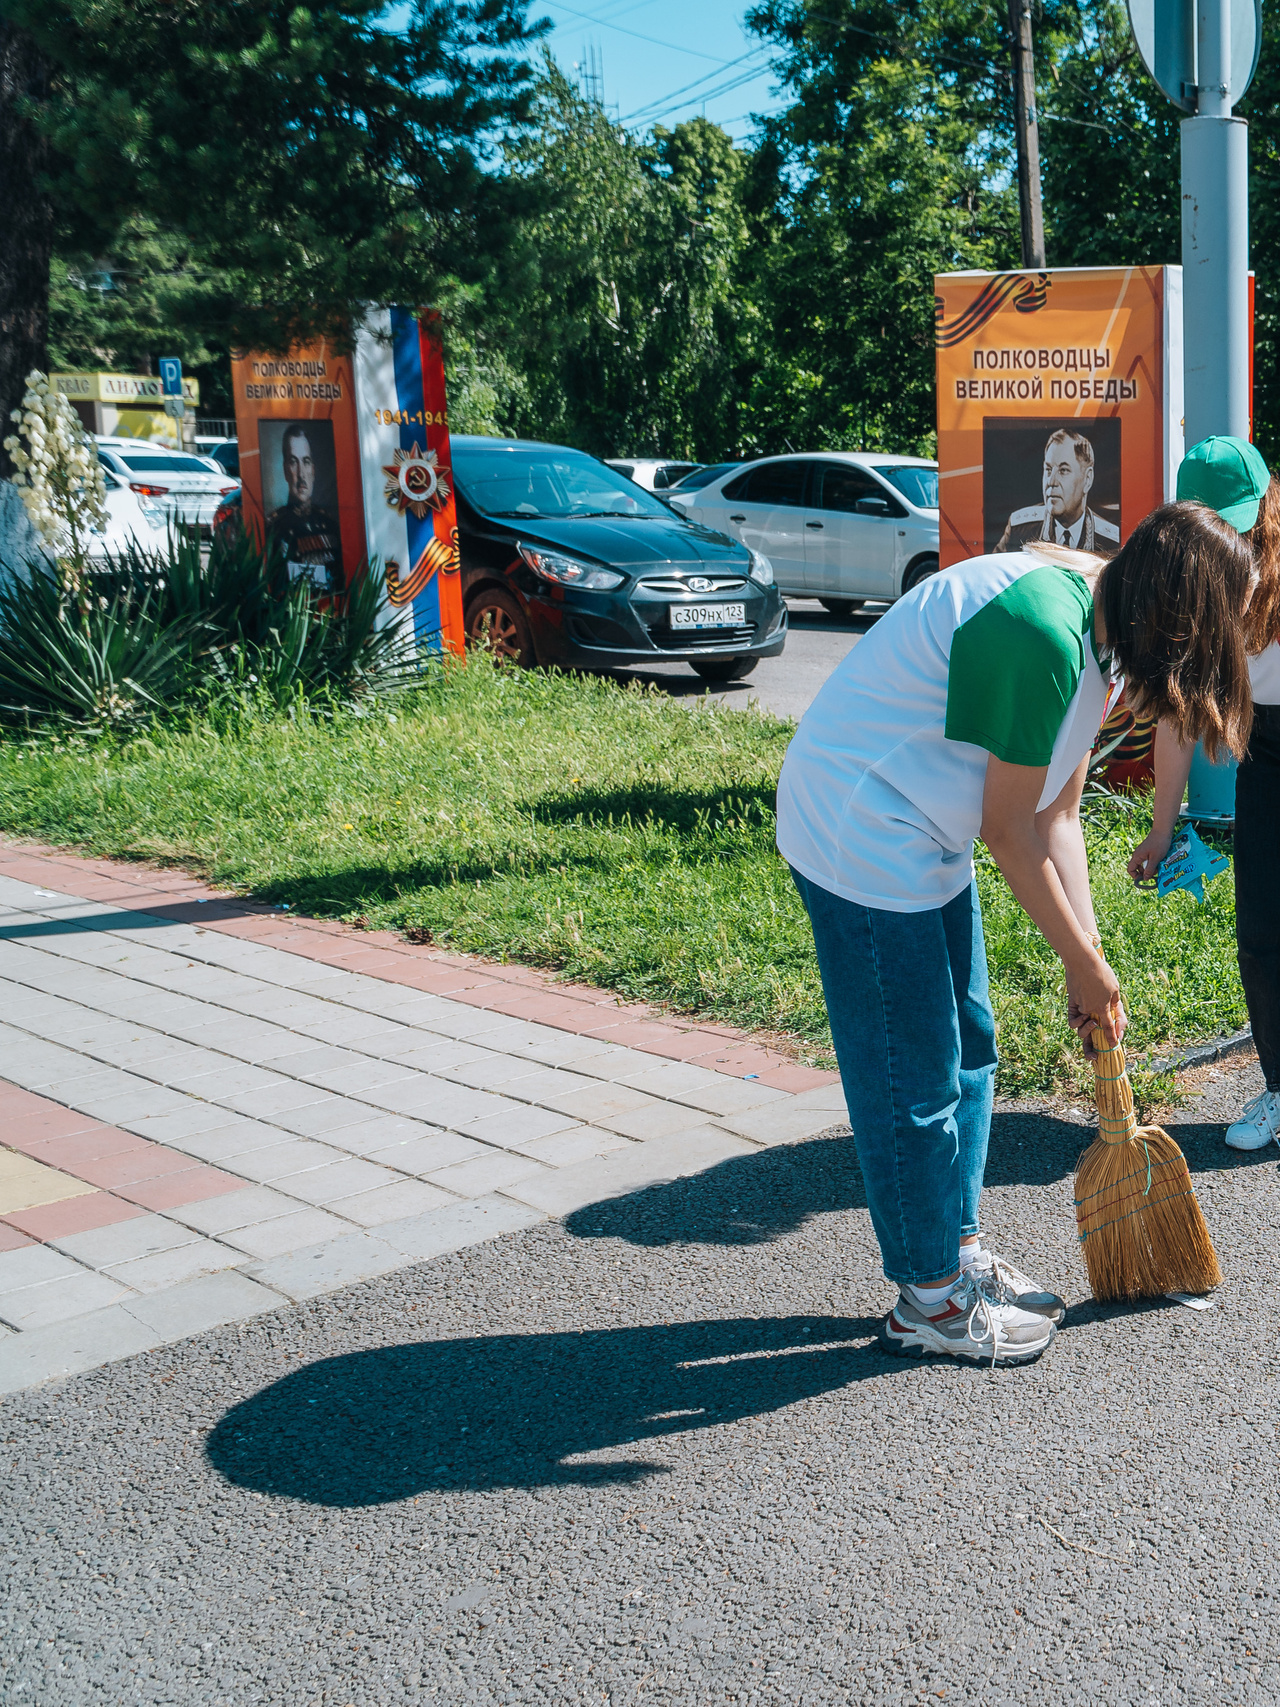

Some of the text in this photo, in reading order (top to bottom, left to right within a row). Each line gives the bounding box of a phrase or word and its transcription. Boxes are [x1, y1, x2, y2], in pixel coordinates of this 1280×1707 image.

[252, 360, 327, 378] ПОЛКОВОДЦЫ
[973, 348, 1110, 372] ПОЛКОВОДЦЫ
[105, 378, 195, 399] ЛИМОД
[245, 382, 342, 400] ВЕЛИКОЙ ПОБЕДЫ
[956, 375, 1137, 403] ВЕЛИКОЙ ПОБЕДЫ
[374, 408, 449, 426] 1941-1945
[725, 605, 743, 617] 123
